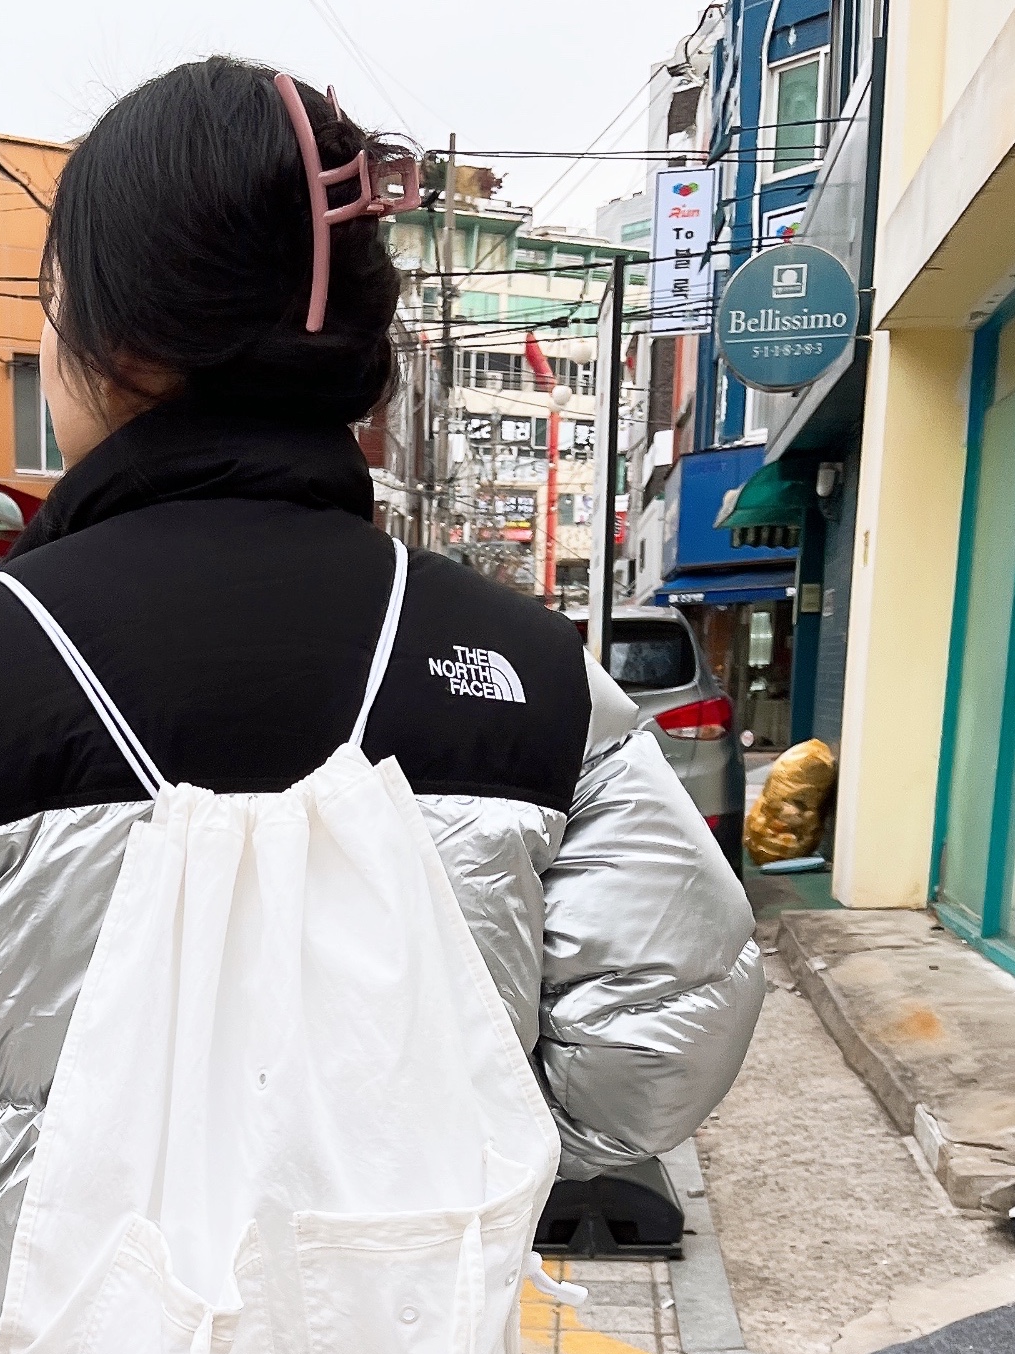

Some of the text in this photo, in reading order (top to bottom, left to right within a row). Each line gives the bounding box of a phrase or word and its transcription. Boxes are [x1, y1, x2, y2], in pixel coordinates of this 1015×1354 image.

[672, 227, 694, 240] To
[727, 309, 847, 334] Bellissimo
[452, 645, 489, 667] THE
[428, 657, 491, 683] NORTH
[449, 677, 496, 699] FACE
